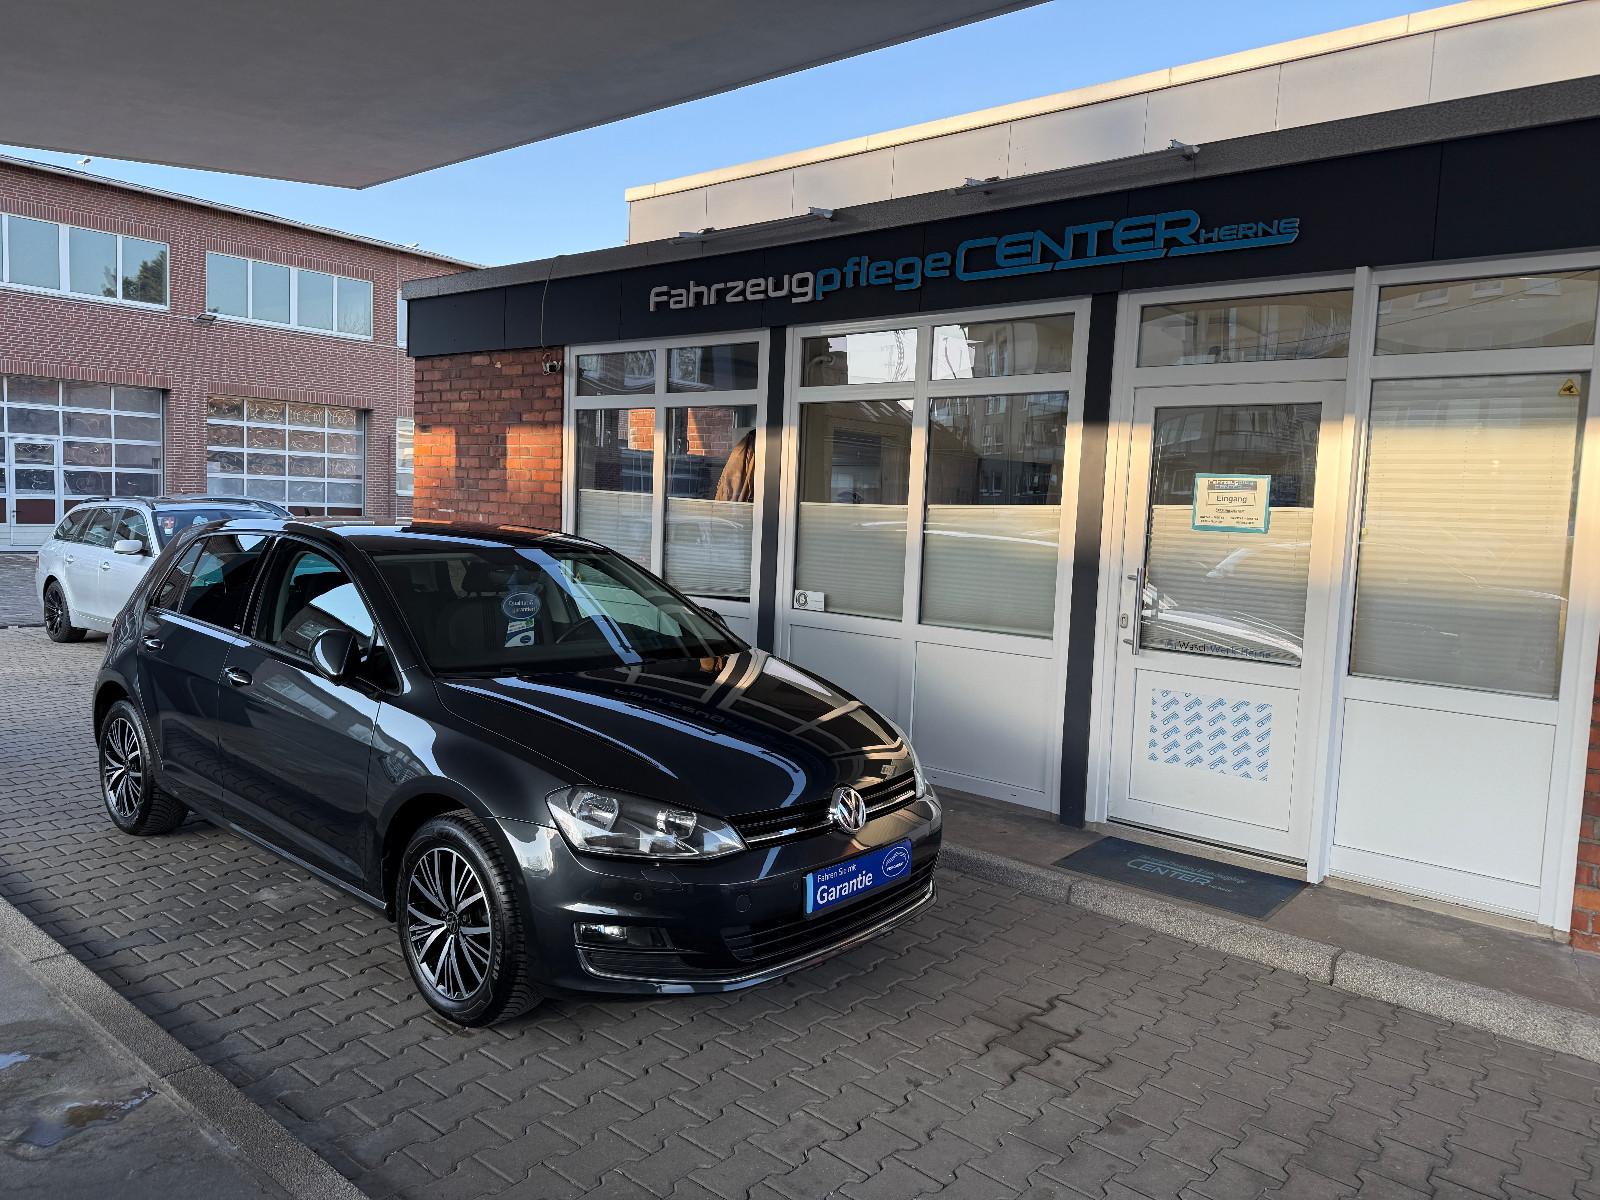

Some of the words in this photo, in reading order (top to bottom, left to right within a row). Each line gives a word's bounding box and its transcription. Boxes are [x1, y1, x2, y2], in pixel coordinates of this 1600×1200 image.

[956, 209, 1201, 282] CENTER
[1199, 217, 1300, 244] HERNE
[1216, 495, 1248, 504] Eingang
[817, 870, 838, 883] Fahren
[838, 867, 847, 875] Sie
[847, 863, 857, 873] mit
[1127, 859, 1214, 886] CENTER
[816, 870, 873, 905] Garantie
